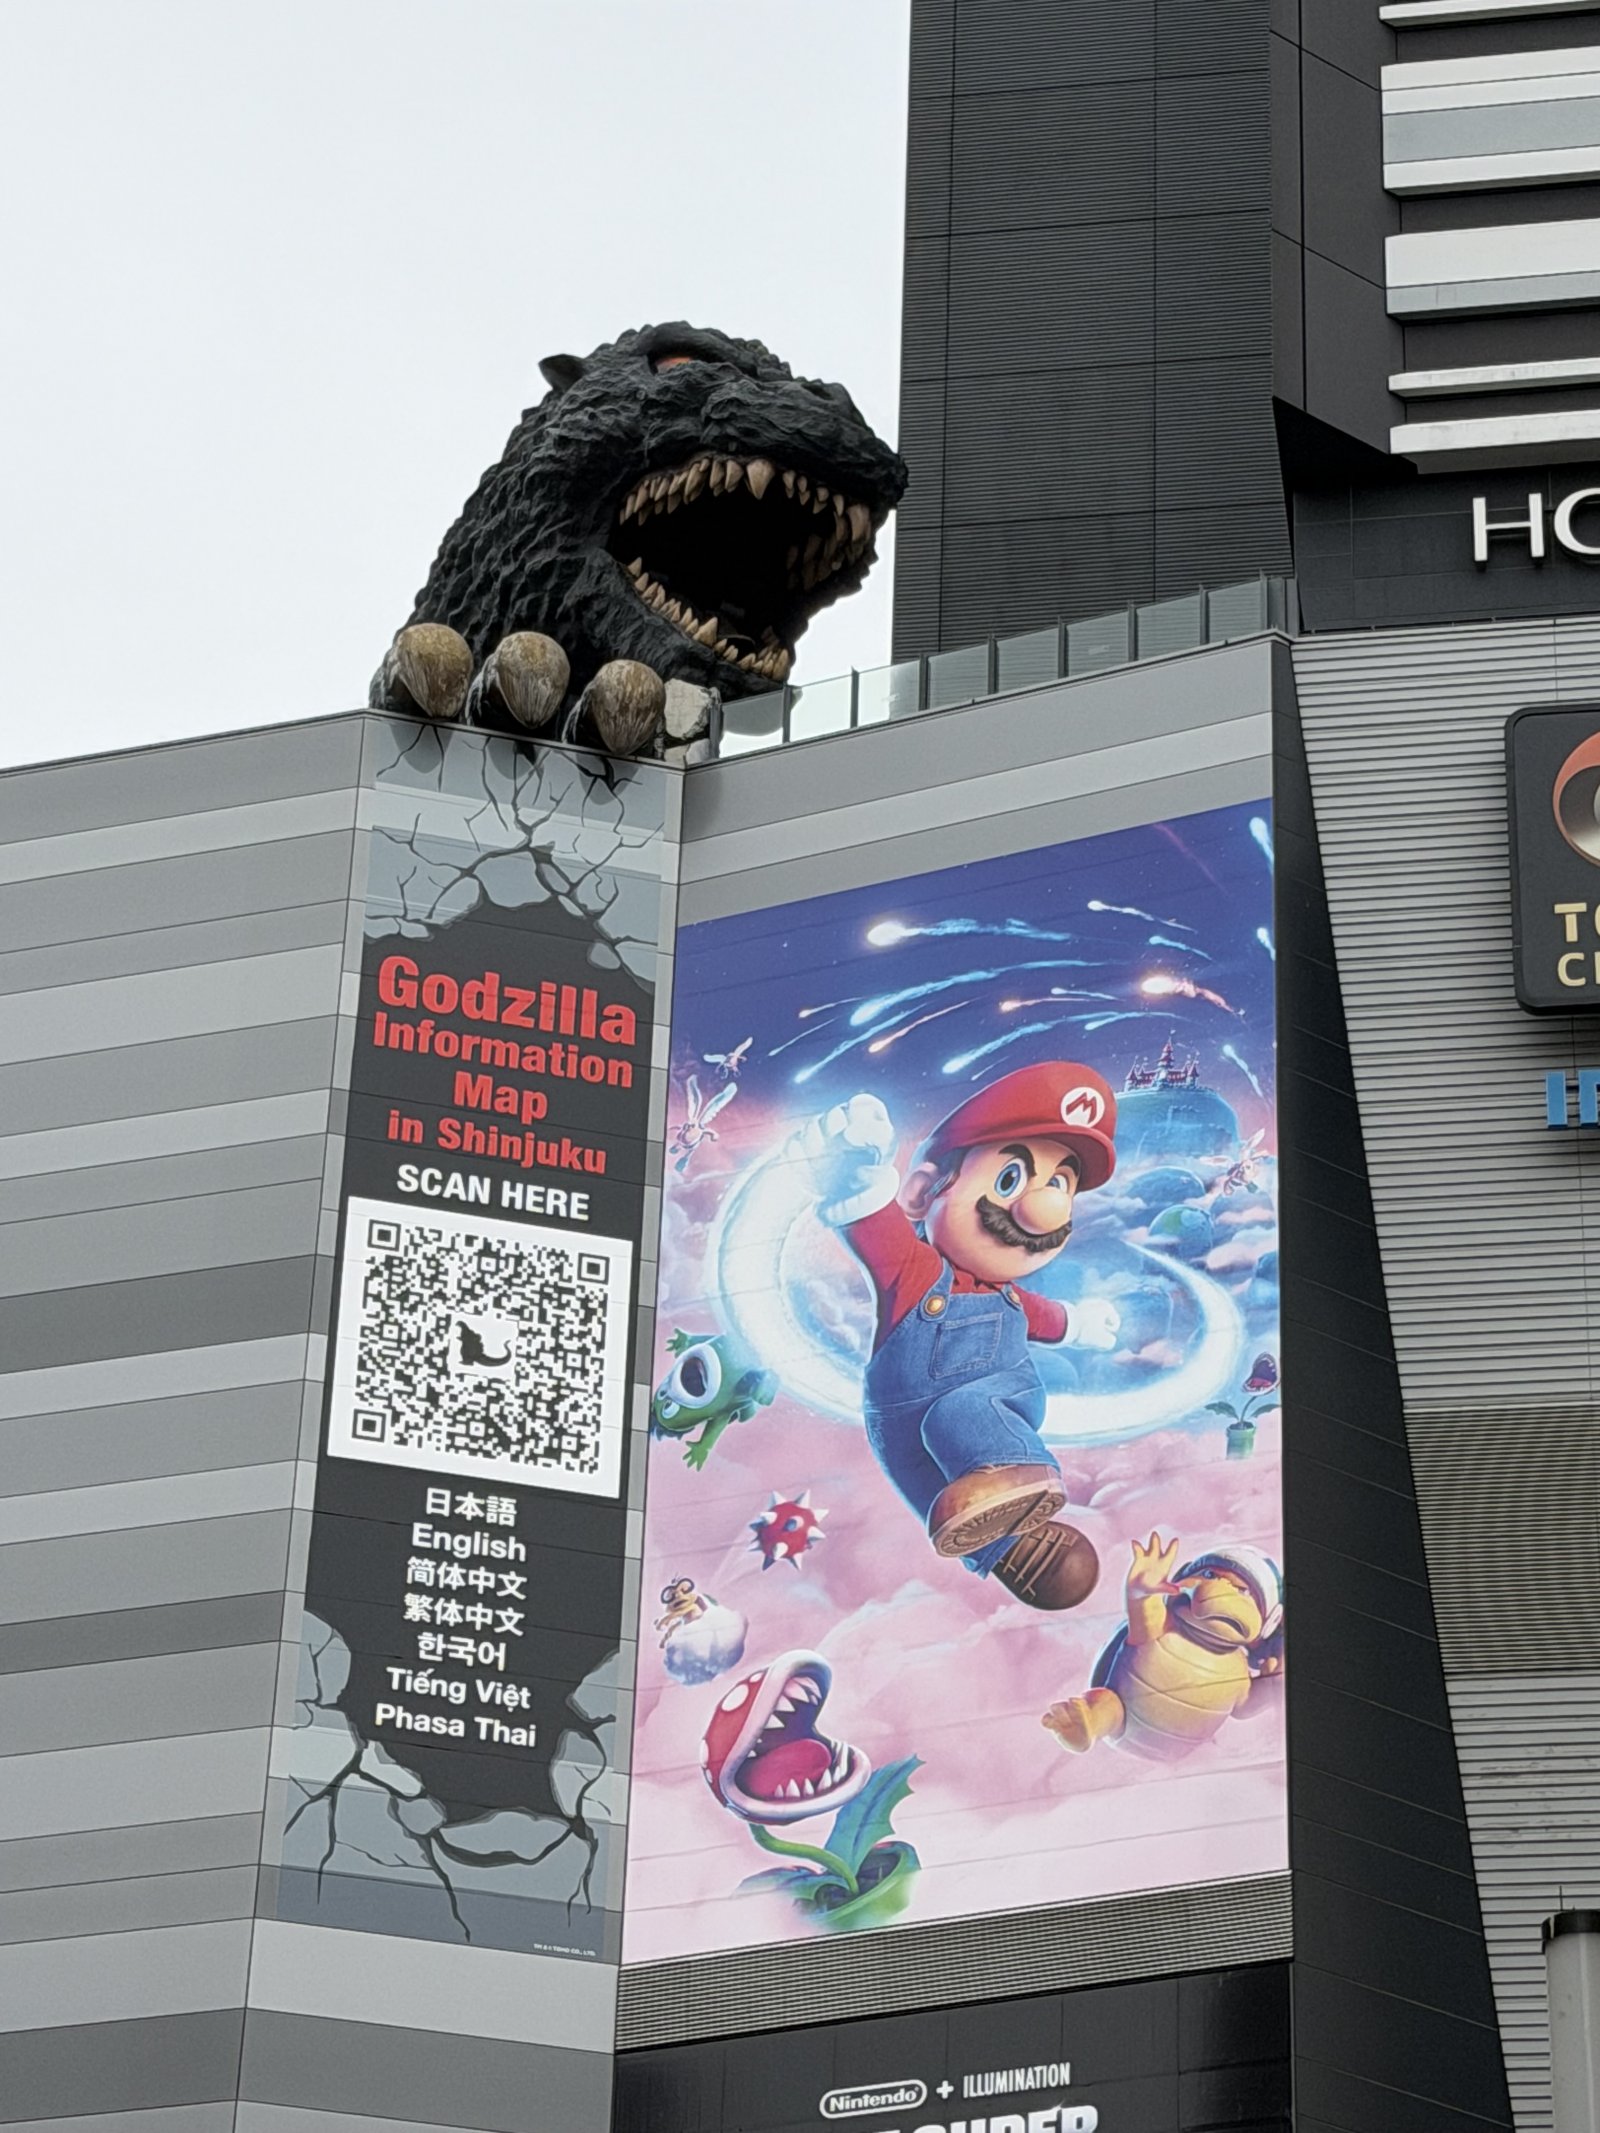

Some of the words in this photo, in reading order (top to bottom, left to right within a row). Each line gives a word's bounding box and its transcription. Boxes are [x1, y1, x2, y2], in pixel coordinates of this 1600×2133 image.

[378, 956, 636, 1045] Godzilla
[373, 1011, 632, 1088] Information
[454, 1071, 548, 1125] Map
[387, 1109, 424, 1143] in
[437, 1117, 606, 1174] Shinjuku
[396, 1163, 491, 1205] SCAN
[500, 1180, 590, 1221] HERE
[425, 1487, 518, 1527] 日本語
[411, 1521, 527, 1562] English
[406, 1555, 528, 1600] 简体中文
[402, 1592, 525, 1637] 繁体中文
[417, 1631, 507, 1672] 한국어
[385, 1666, 467, 1705] Tiếng
[475, 1678, 532, 1713] Việt
[375, 1702, 465, 1738] Phasa
[473, 1716, 537, 1748] Thai
[829, 2087, 917, 2112] Nintendo
[963, 2061, 1071, 2099] ILLUMINATION
